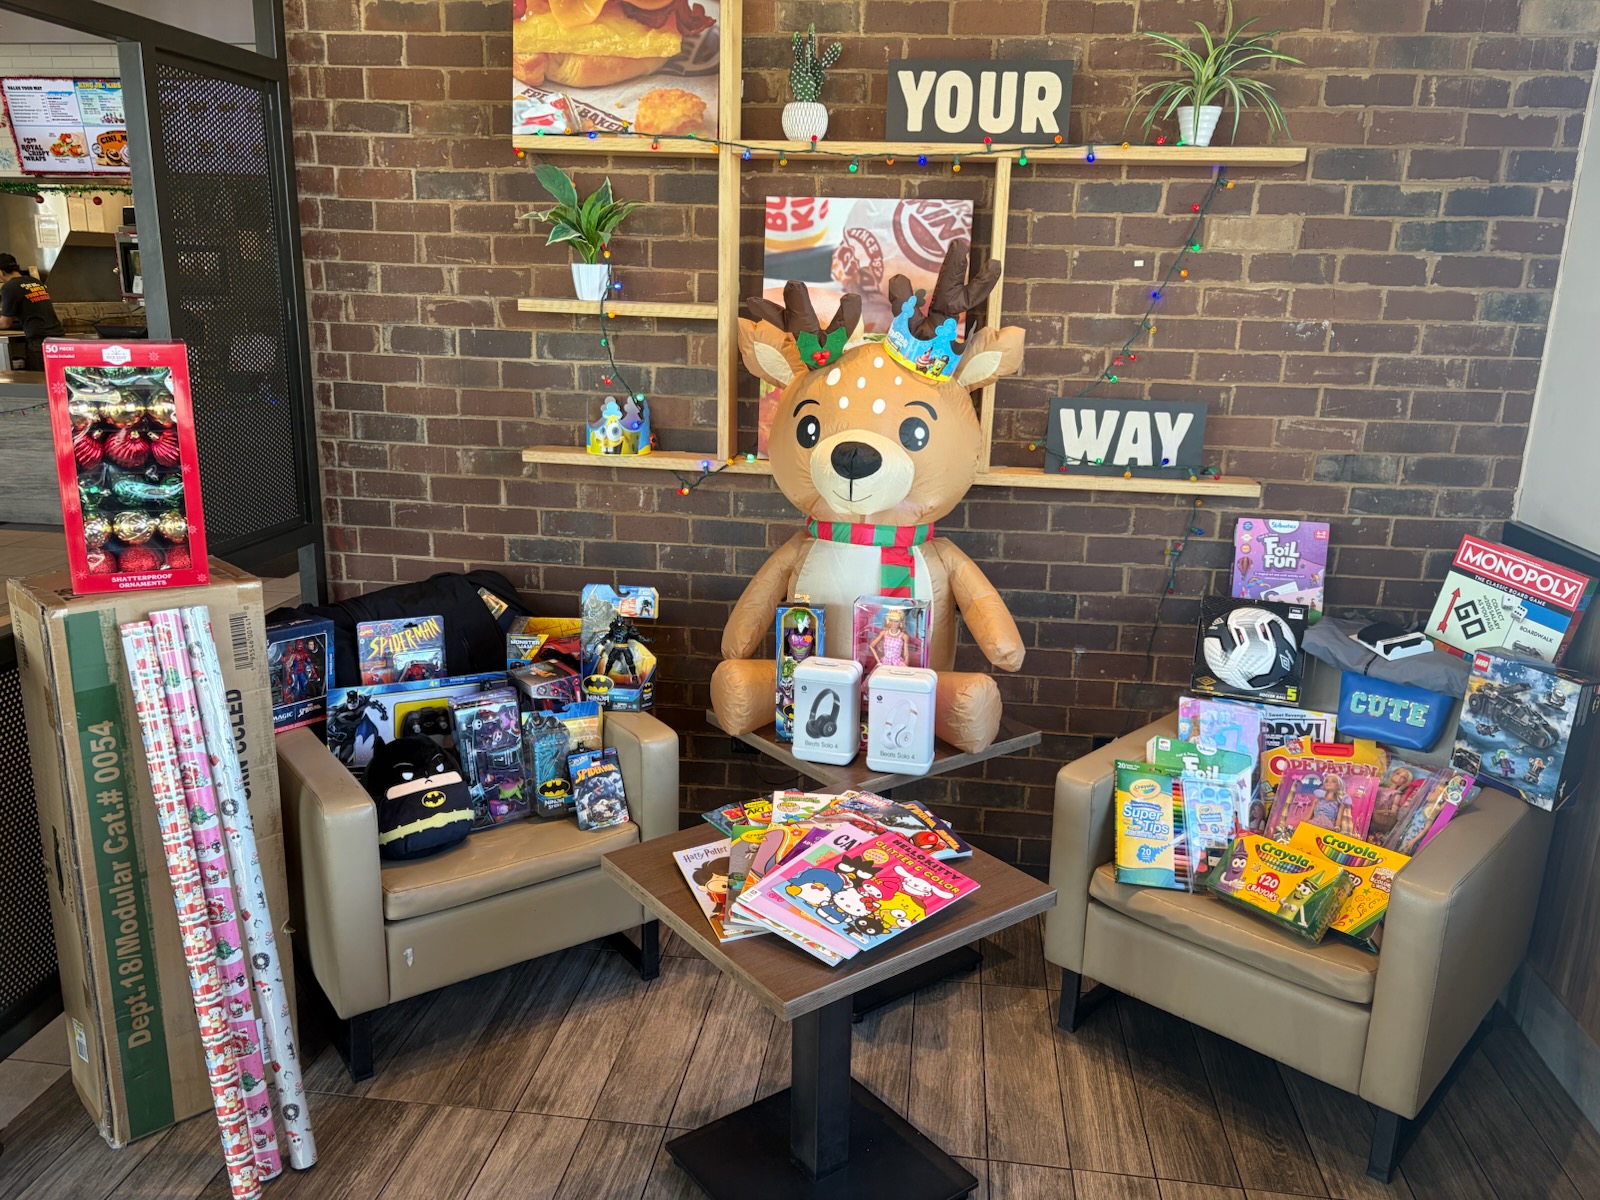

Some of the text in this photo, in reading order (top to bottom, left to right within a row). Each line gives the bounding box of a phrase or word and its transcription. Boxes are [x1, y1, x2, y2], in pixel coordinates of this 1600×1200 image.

[897, 70, 1062, 134] YOUR
[46, 344, 58, 353] 50
[1059, 408, 1194, 466] WAY
[112, 573, 173, 583] SHATTERPROOF
[119, 580, 167, 588] ORNAMENTS
[1463, 546, 1578, 600] MONOPOLY
[1486, 579, 1508, 592] CLASSIC
[1509, 588, 1528, 600] BOARD
[1529, 596, 1546, 606] GAME
[1454, 600, 1487, 640] GO
[1480, 606, 1489, 618] YOU
[1485, 617, 1493, 632] PASS
[1490, 610, 1501, 630] SALARY
[1491, 598, 1504, 622] COLLECT
[367, 617, 442, 660] SPIDER-MAN
[1519, 626, 1554, 644] BOARDWALK
[1287, 688, 1297, 700] 5
[1350, 691, 1429, 728] CUTE
[575, 764, 618, 784] SPIDER-MAN
[1270, 756, 1380, 777] OPERATION
[1123, 805, 1163, 820] Super
[1143, 820, 1169, 834] Tips
[683, 846, 727, 862] Harry Potter
[1261, 842, 1310, 868] Crayola
[1323, 834, 1377, 860] Crayola
[876, 841, 914, 866] GLITTER
[924, 872, 960, 893] COLOR
[893, 840, 926, 860] HELLO
[925, 859, 960, 880] KITTY
[88, 720, 153, 1050] Dept.18/Modular Cat.# 0054
[1247, 883, 1278, 902] CRAYONS
[1258, 873, 1278, 888] 120
